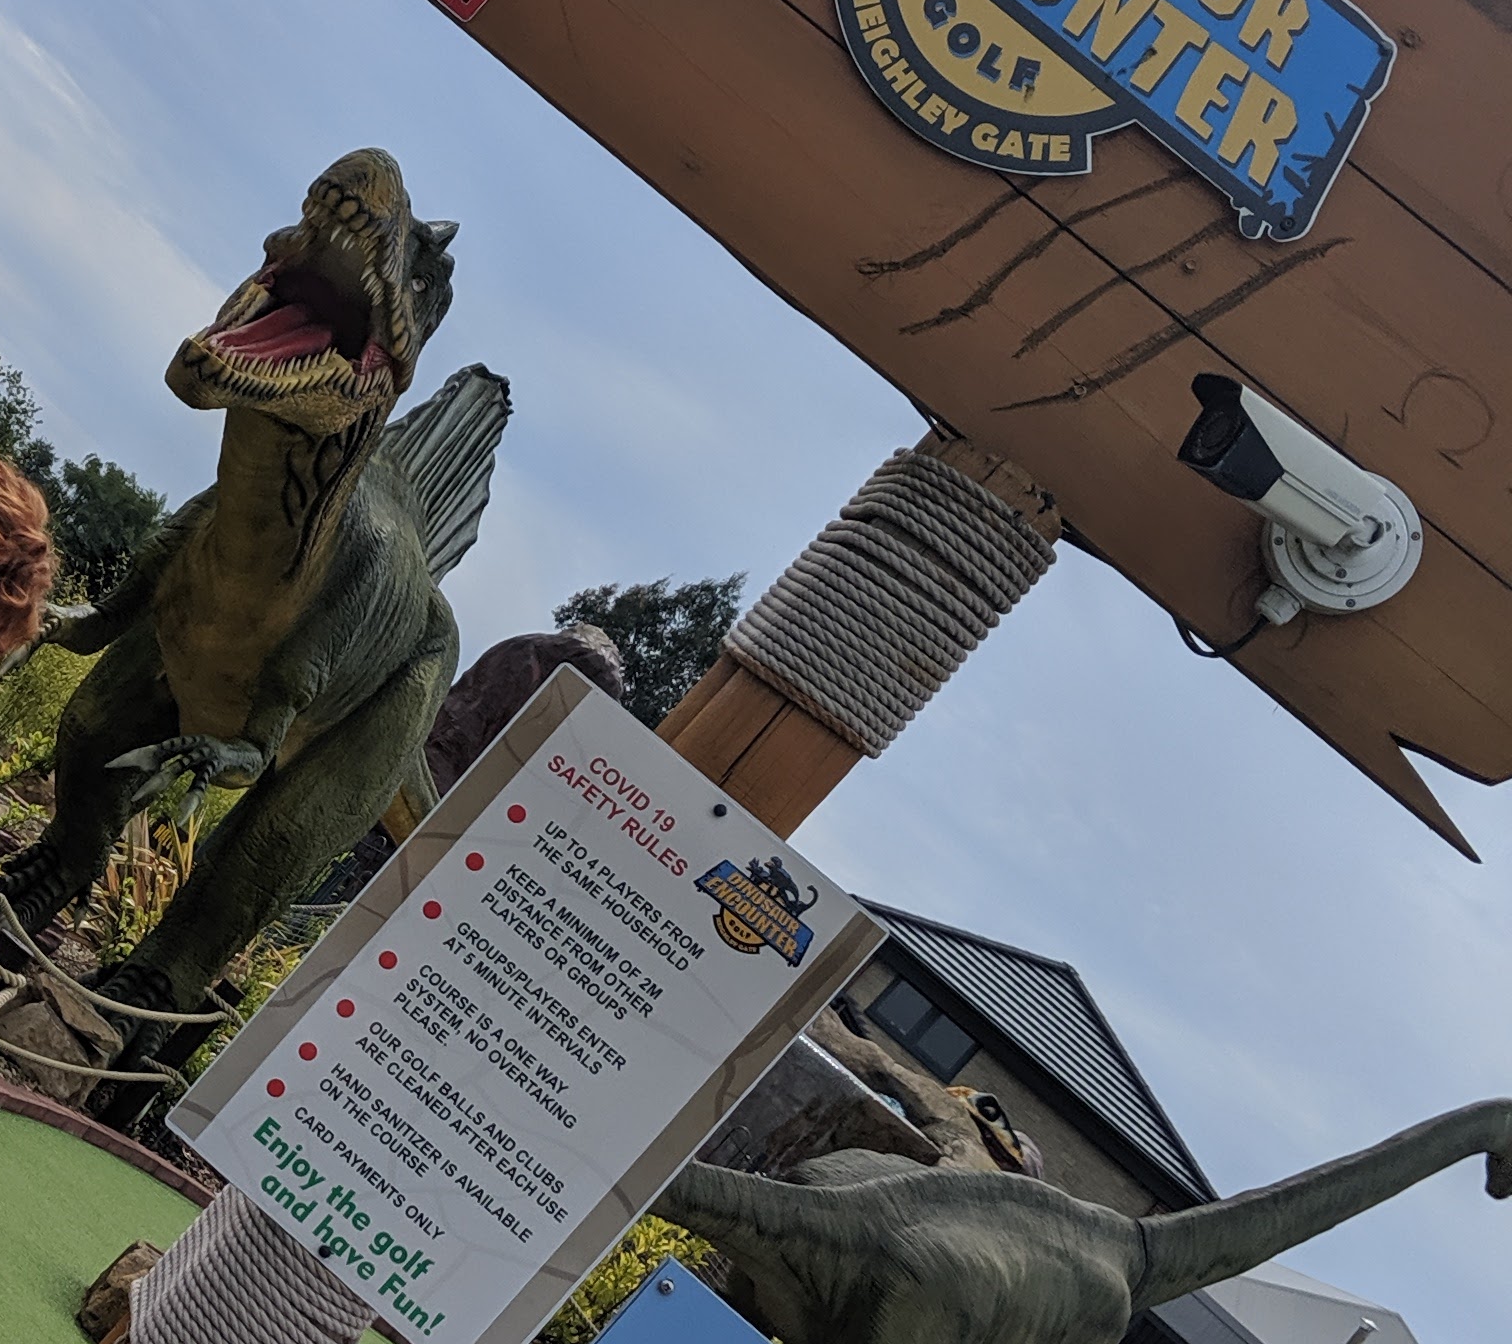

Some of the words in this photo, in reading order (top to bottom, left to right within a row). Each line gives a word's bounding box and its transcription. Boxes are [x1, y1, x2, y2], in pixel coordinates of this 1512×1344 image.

[971, 121, 1071, 162] GATE
[547, 754, 626, 820] SAFETY
[620, 816, 689, 877] RULES
[588, 756, 650, 811] COVID
[649, 808, 676, 834] 19
[480, 891, 545, 950] PLAYERS
[543, 946, 568, 971] OR
[566, 966, 628, 1020] GROUPS
[492, 877, 564, 941] DISTANCE
[560, 935, 606, 976] FROM
[603, 971, 654, 1019] OTHER
[505, 863, 547, 897] KEEP
[541, 897, 557, 912] A
[555, 905, 621, 964] MINIMUM
[617, 959, 642, 978] OF
[637, 976, 664, 1000] 2M
[532, 834, 564, 865] THE
[560, 860, 605, 900] SAME
[600, 893, 689, 971] HOUSEHOLD
[544, 820, 568, 840] UP
[566, 837, 588, 860] TO
[586, 858, 600, 870] 4
[596, 865, 663, 924] PLAYERS
[659, 918, 706, 960] FROM
[705, 876, 798, 958] ENCOUNTER
[392, 991, 450, 1047] PLEASE.
[405, 978, 464, 1036] SYSTEM,
[463, 1028, 489, 1052] NO
[487, 1048, 577, 1129] OVERTAKING
[418, 964, 479, 1019] COURSE
[475, 1012, 493, 1031] IS
[489, 1027, 504, 1043] A
[503, 1037, 537, 1069] ONE
[534, 1062, 569, 1095] WAY
[441, 936, 467, 955] AT
[462, 951, 476, 965] 5
[472, 960, 529, 1011] MINUTE
[524, 1005, 603, 1075] INTERVALS
[456, 921, 579, 1029] GROUPS/PLAYERS
[576, 1024, 627, 1071] ENTER
[294, 1106, 335, 1144] CARD
[332, 1139, 406, 1208] PAYMENTS
[404, 1204, 445, 1240] ONLY
[319, 1078, 344, 1102] ON
[341, 1095, 372, 1128] THE
[369, 1122, 430, 1178] COURSE
[330, 1062, 372, 1102] HAND
[370, 1098, 443, 1165] SANITIZER
[439, 1158, 458, 1178] IS
[454, 1174, 533, 1244] AVAILABLE
[354, 1036, 389, 1066] ARE
[386, 1061, 452, 1121] CLEANED
[448, 1118, 498, 1163] AFTER
[494, 1156, 538, 1197] EACH
[535, 1191, 569, 1224] USE
[368, 1021, 402, 1054] OUR
[400, 1048, 441, 1083] GOLF
[437, 1080, 486, 1126] BALLS
[482, 1122, 516, 1152] AND
[515, 1149, 565, 1194] CLUBS
[252, 1116, 326, 1191] Enjoy
[325, 1184, 371, 1232] the
[367, 1231, 435, 1280] golf
[260, 1174, 319, 1224] and
[311, 1213, 381, 1281] have
[377, 1271, 446, 1336] Fun!
